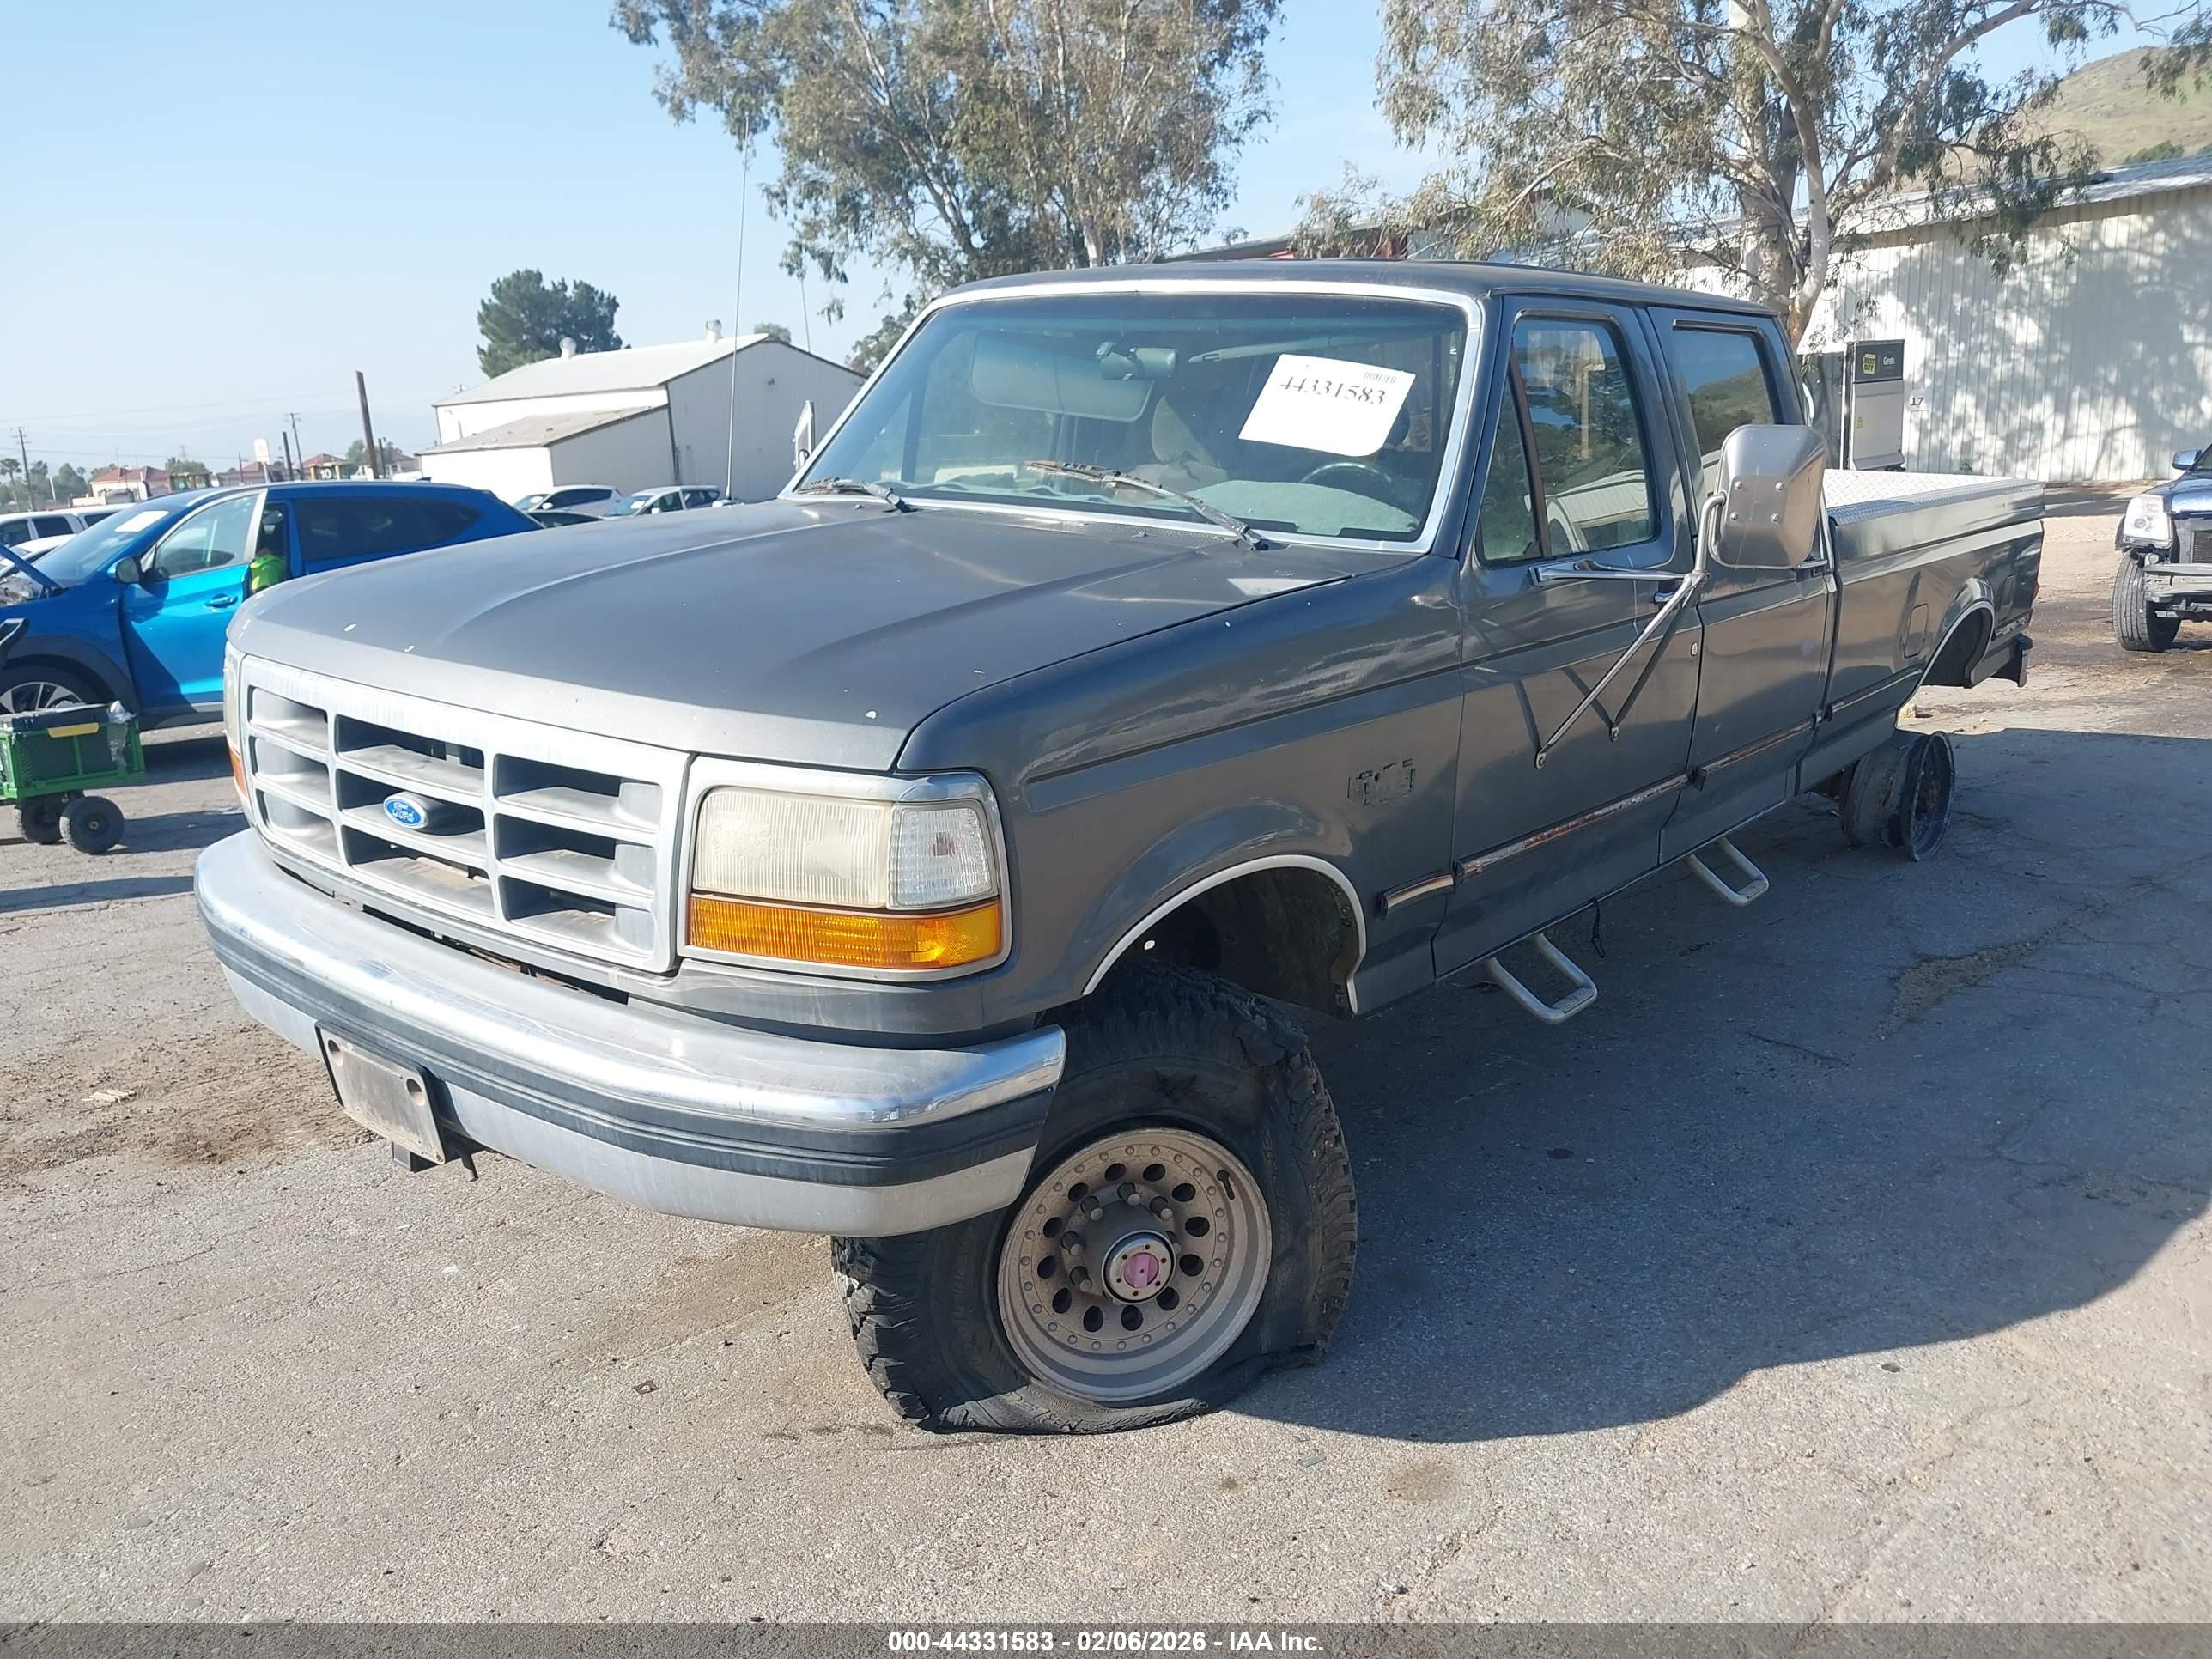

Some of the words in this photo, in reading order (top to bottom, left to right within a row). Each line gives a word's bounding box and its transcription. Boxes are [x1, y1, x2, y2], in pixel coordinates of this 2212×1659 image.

[1280, 377, 1385, 404] 44331583
[1911, 397, 1923, 406] 17
[319, 468, 331, 479] 10
[392, 802, 415, 822] Ford
